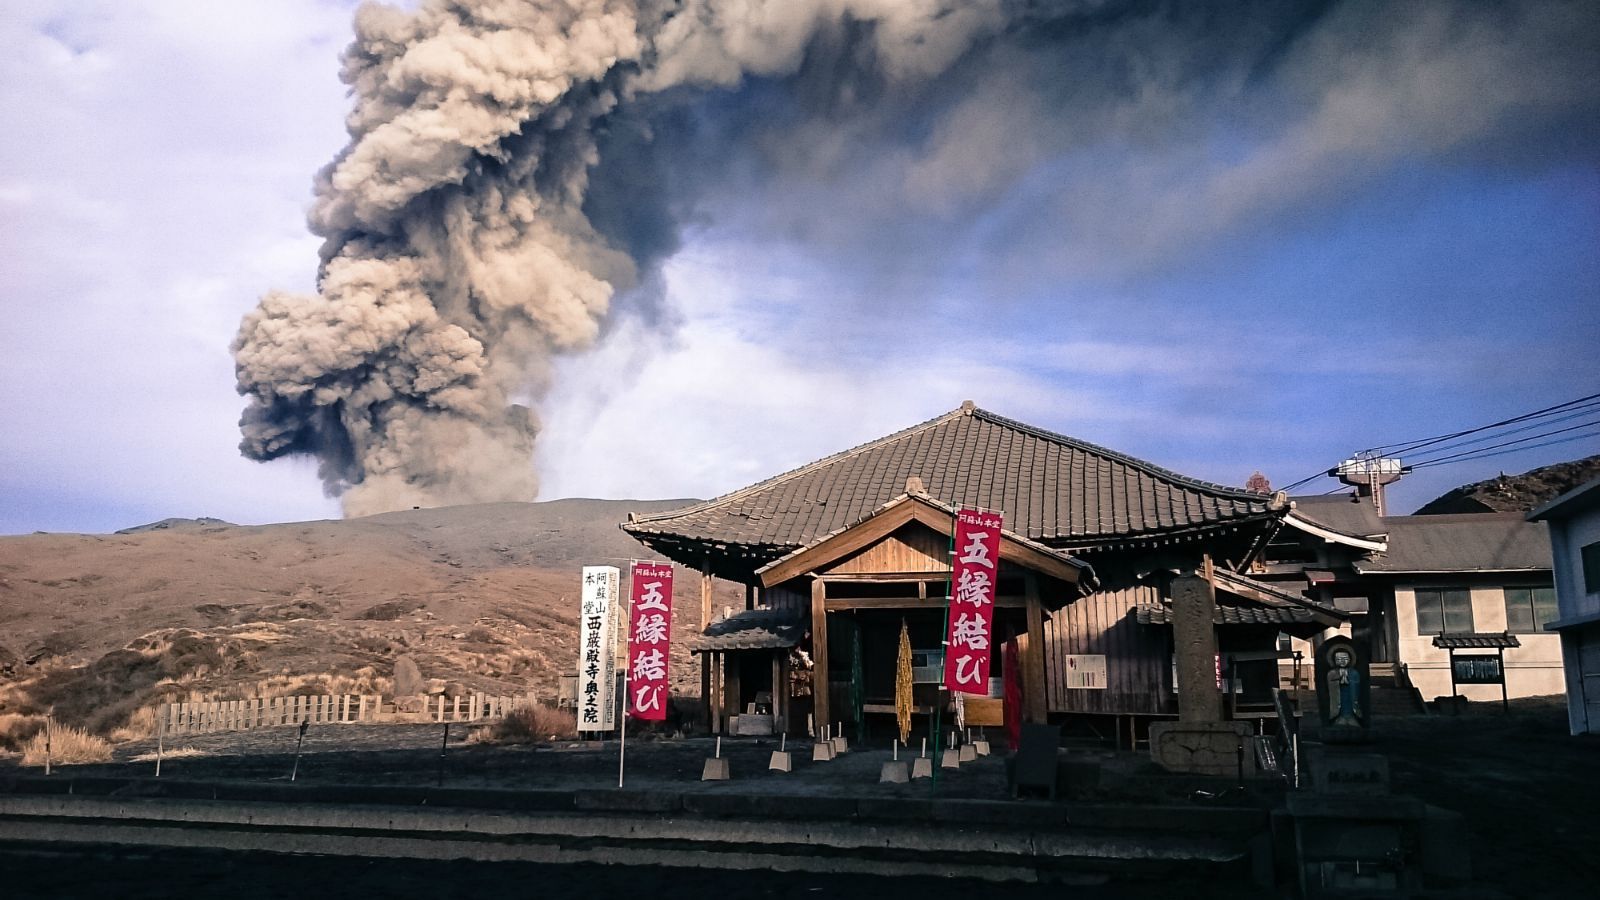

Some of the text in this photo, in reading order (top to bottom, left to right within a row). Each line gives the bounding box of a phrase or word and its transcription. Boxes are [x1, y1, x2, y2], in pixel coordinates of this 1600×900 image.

[583, 572, 595, 615] 本堂
[596, 572, 607, 614] 阿蘇山
[952, 531, 994, 685] 五縁結び
[633, 581, 669, 713] 五縁結び
